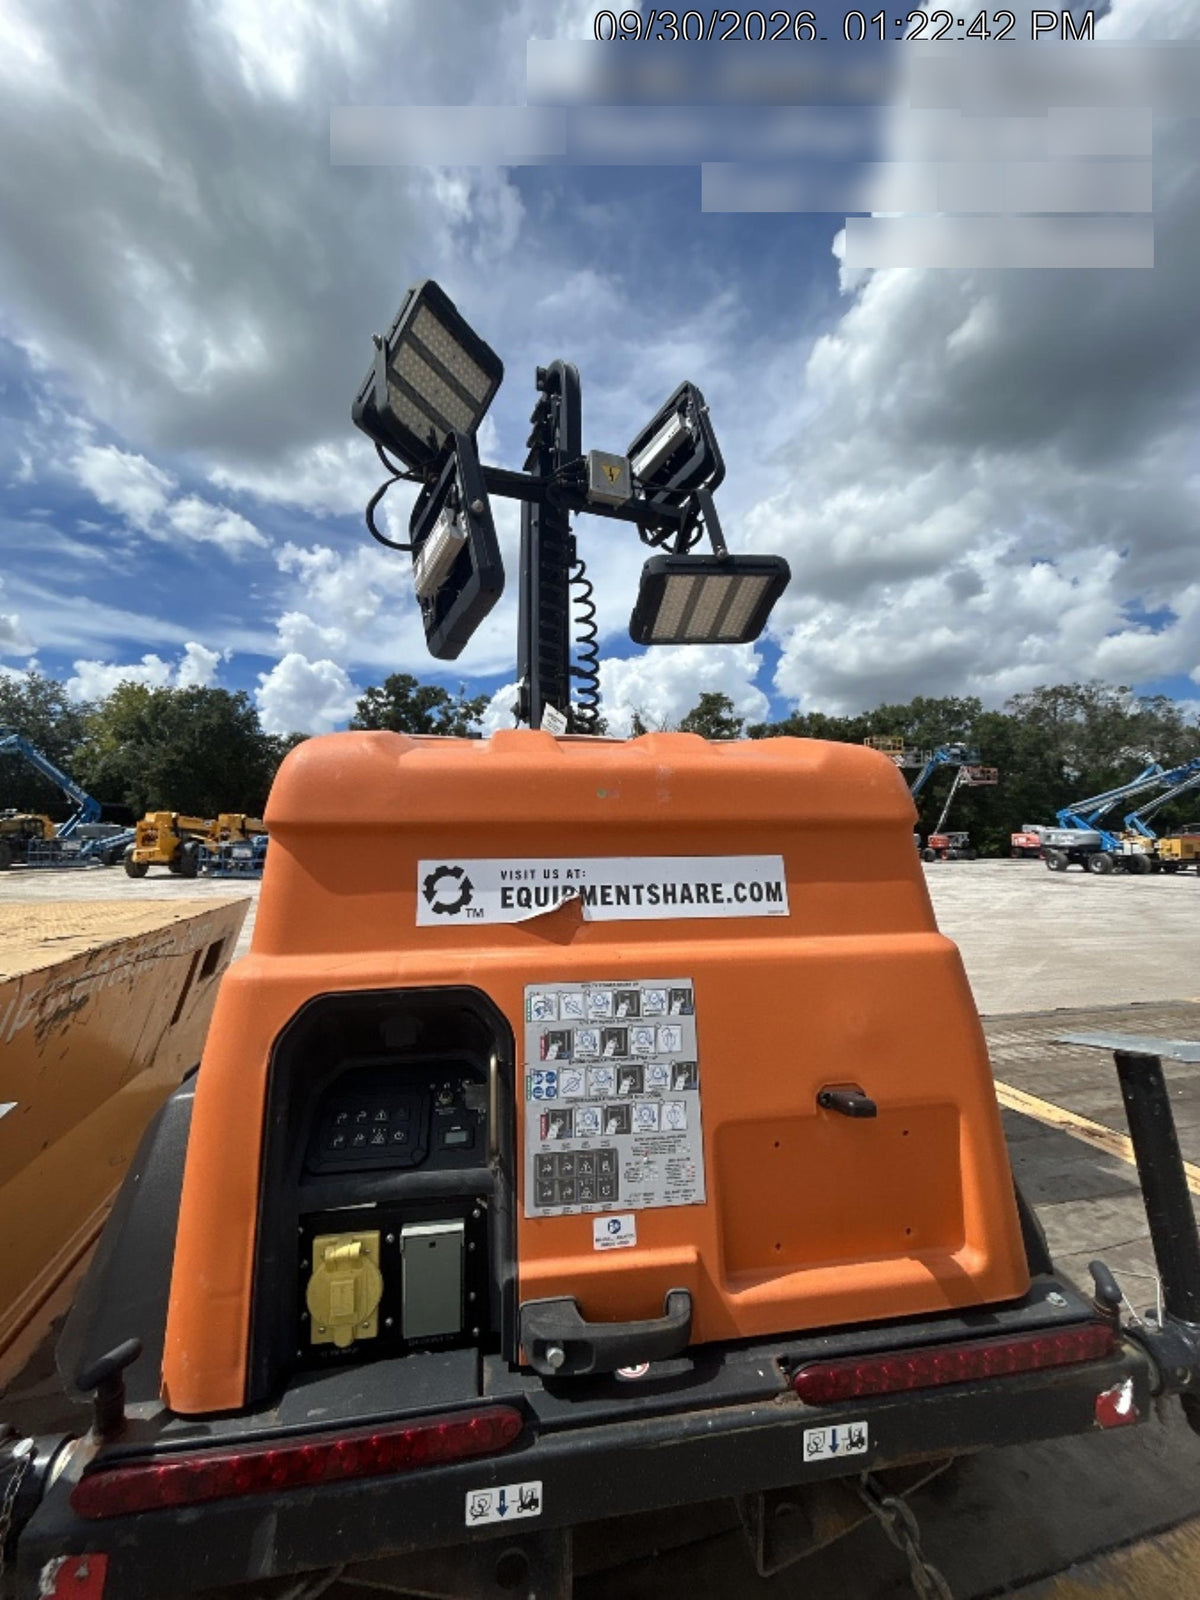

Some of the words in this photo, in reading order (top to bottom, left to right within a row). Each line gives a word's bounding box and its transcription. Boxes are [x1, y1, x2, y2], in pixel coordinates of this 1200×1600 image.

[500, 869, 537, 880] VISIT
[543, 869, 559, 879] US
[566, 868, 586, 879] AT:
[465, 908, 484, 918] TM
